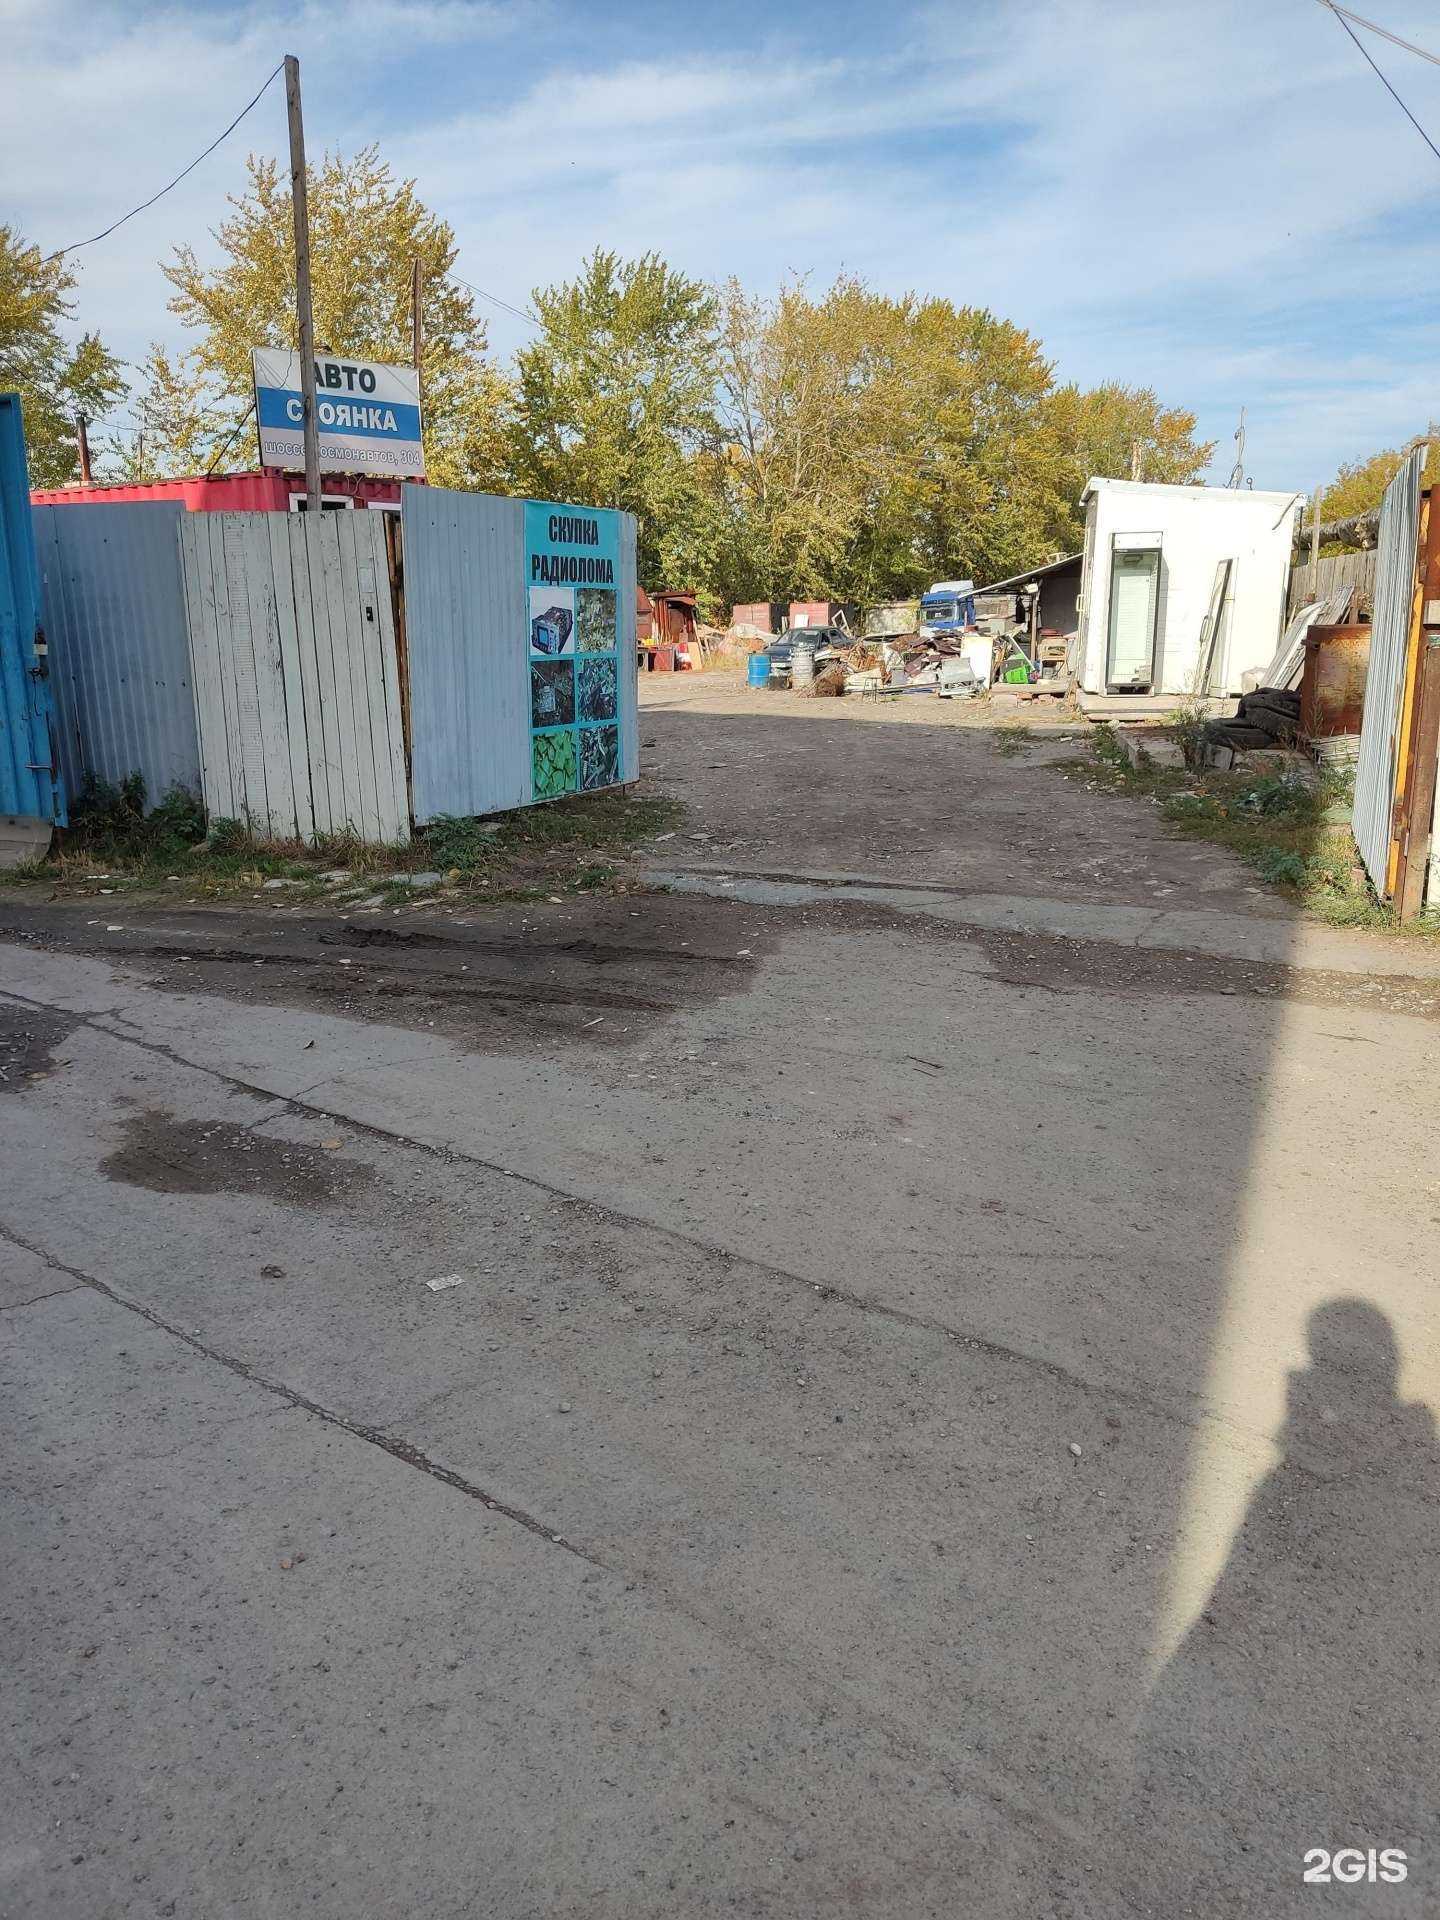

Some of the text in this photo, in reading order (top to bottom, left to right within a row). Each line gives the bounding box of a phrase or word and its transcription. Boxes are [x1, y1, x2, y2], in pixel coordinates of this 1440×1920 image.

[286, 399, 398, 432] СОЯНКА
[319, 445, 399, 465] осмонавтов,
[401, 450, 421, 466] 304
[548, 515, 599, 545] СКУПКА
[531, 554, 614, 587] РАДИОЛОМА
